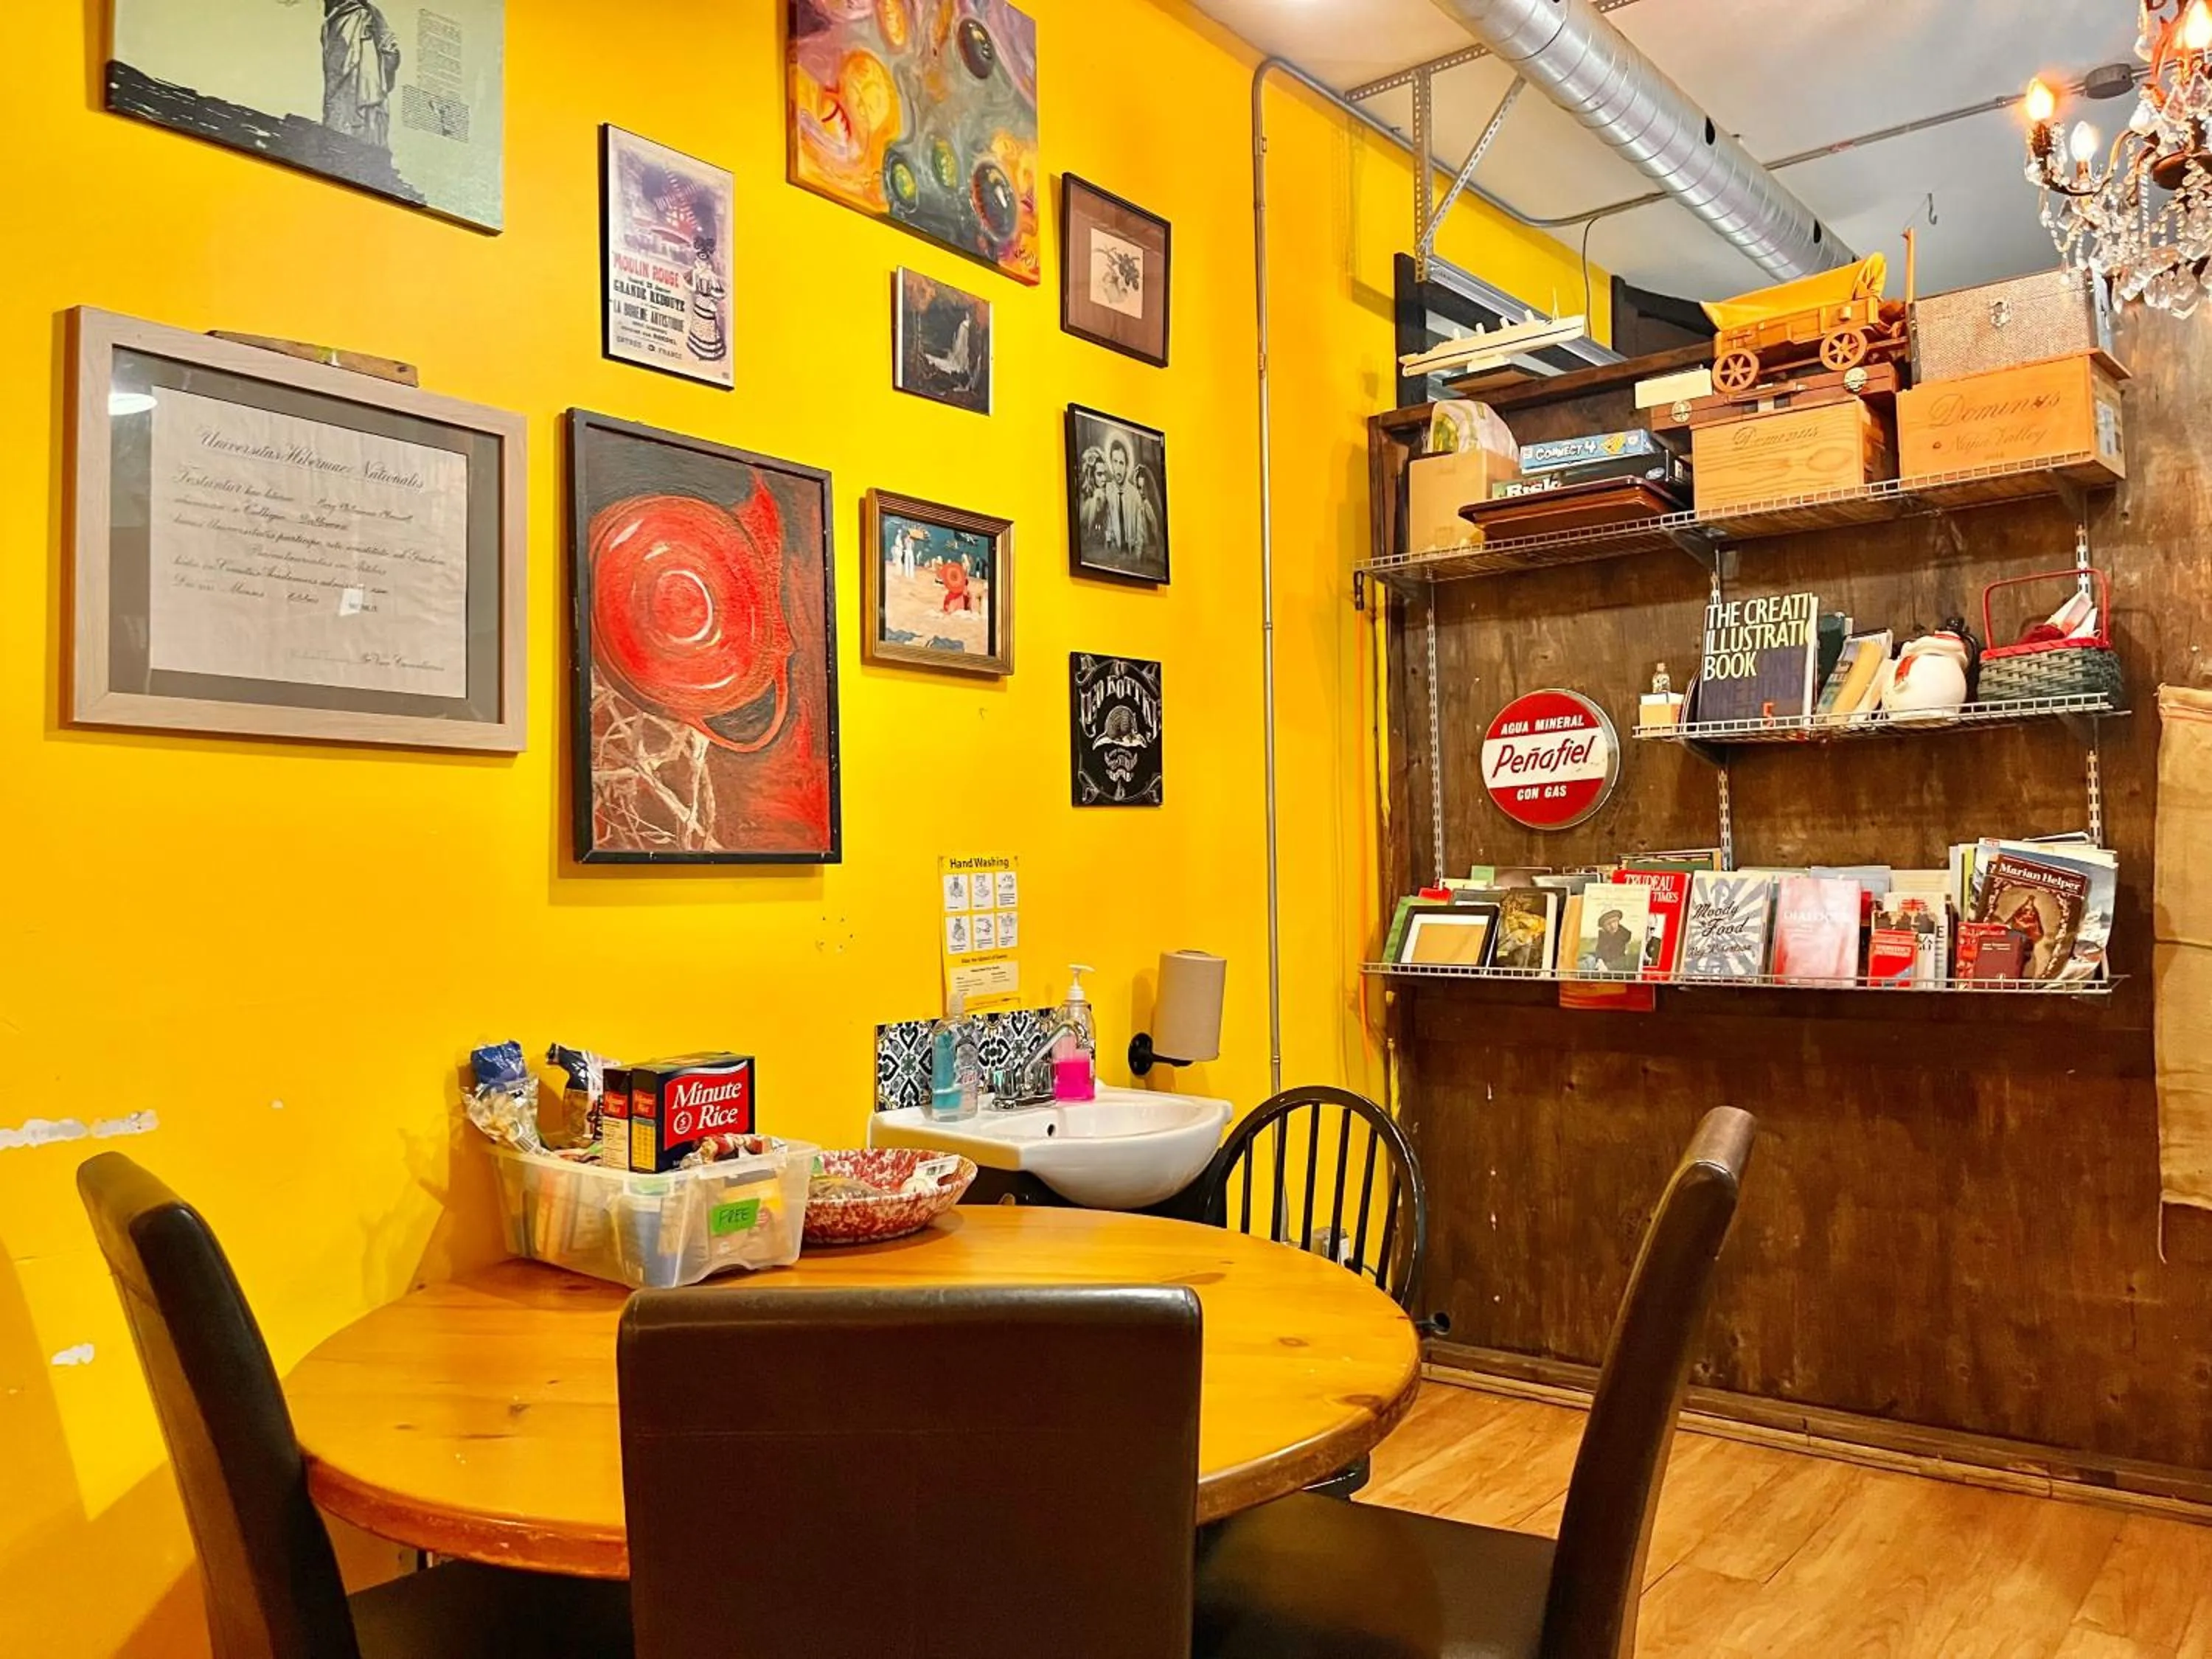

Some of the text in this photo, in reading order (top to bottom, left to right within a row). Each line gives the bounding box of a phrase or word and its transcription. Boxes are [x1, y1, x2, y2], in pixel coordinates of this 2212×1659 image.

[613, 279, 647, 300] GRANDE
[1929, 391, 2061, 428] Dominus
[1585, 440, 1597, 454] 4
[1706, 601, 1742, 629] THE
[1703, 651, 1757, 682] BOOK
[1500, 714, 1585, 735] AGUA MINERAL
[1492, 735, 1598, 779] Peñafiel
[1516, 785, 1567, 801] CON GAS
[950, 857, 1009, 869] Hand Washing
[1624, 874, 1675, 891] TRUDEAU
[1999, 862, 2081, 891] Marian Helper
[1652, 891, 1679, 903] TIMES
[1692, 900, 1739, 921] Moody
[1702, 916, 1750, 937] Food
[671, 1082, 742, 1110] Minute
[696, 1104, 738, 1130] Rice
